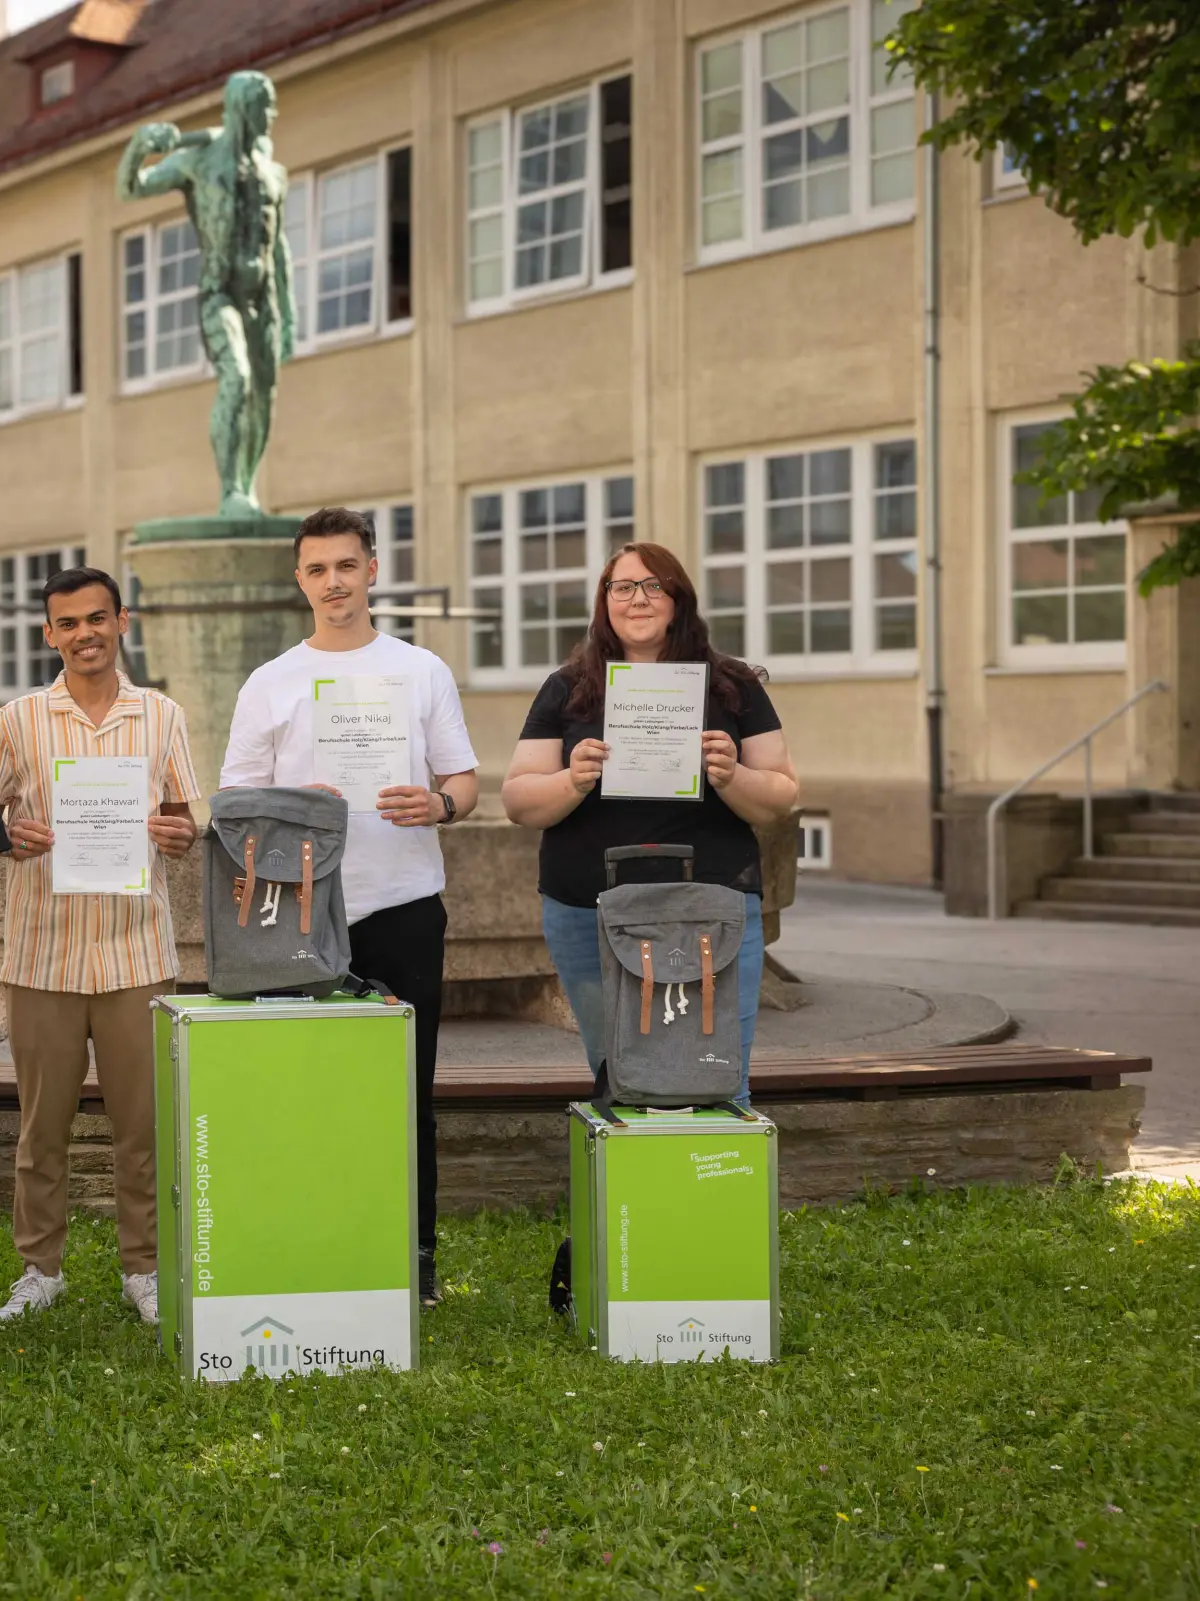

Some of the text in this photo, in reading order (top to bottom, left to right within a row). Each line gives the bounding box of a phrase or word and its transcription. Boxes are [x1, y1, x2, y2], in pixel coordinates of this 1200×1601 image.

[614, 703, 695, 712] Michelle Drucker
[330, 714, 391, 724] Oliver Nikaj
[60, 798, 139, 806] Mortaza Khawari
[696, 1161, 722, 1172] young
[697, 1165, 750, 1180] professionals
[194, 1114, 214, 1292] www.sto-stiftung.de
[622, 1204, 630, 1293] www.sto-stiftung.de
[656, 1332, 752, 1344] Sto Stiftung
[200, 1346, 384, 1370] Sto Stiftung
